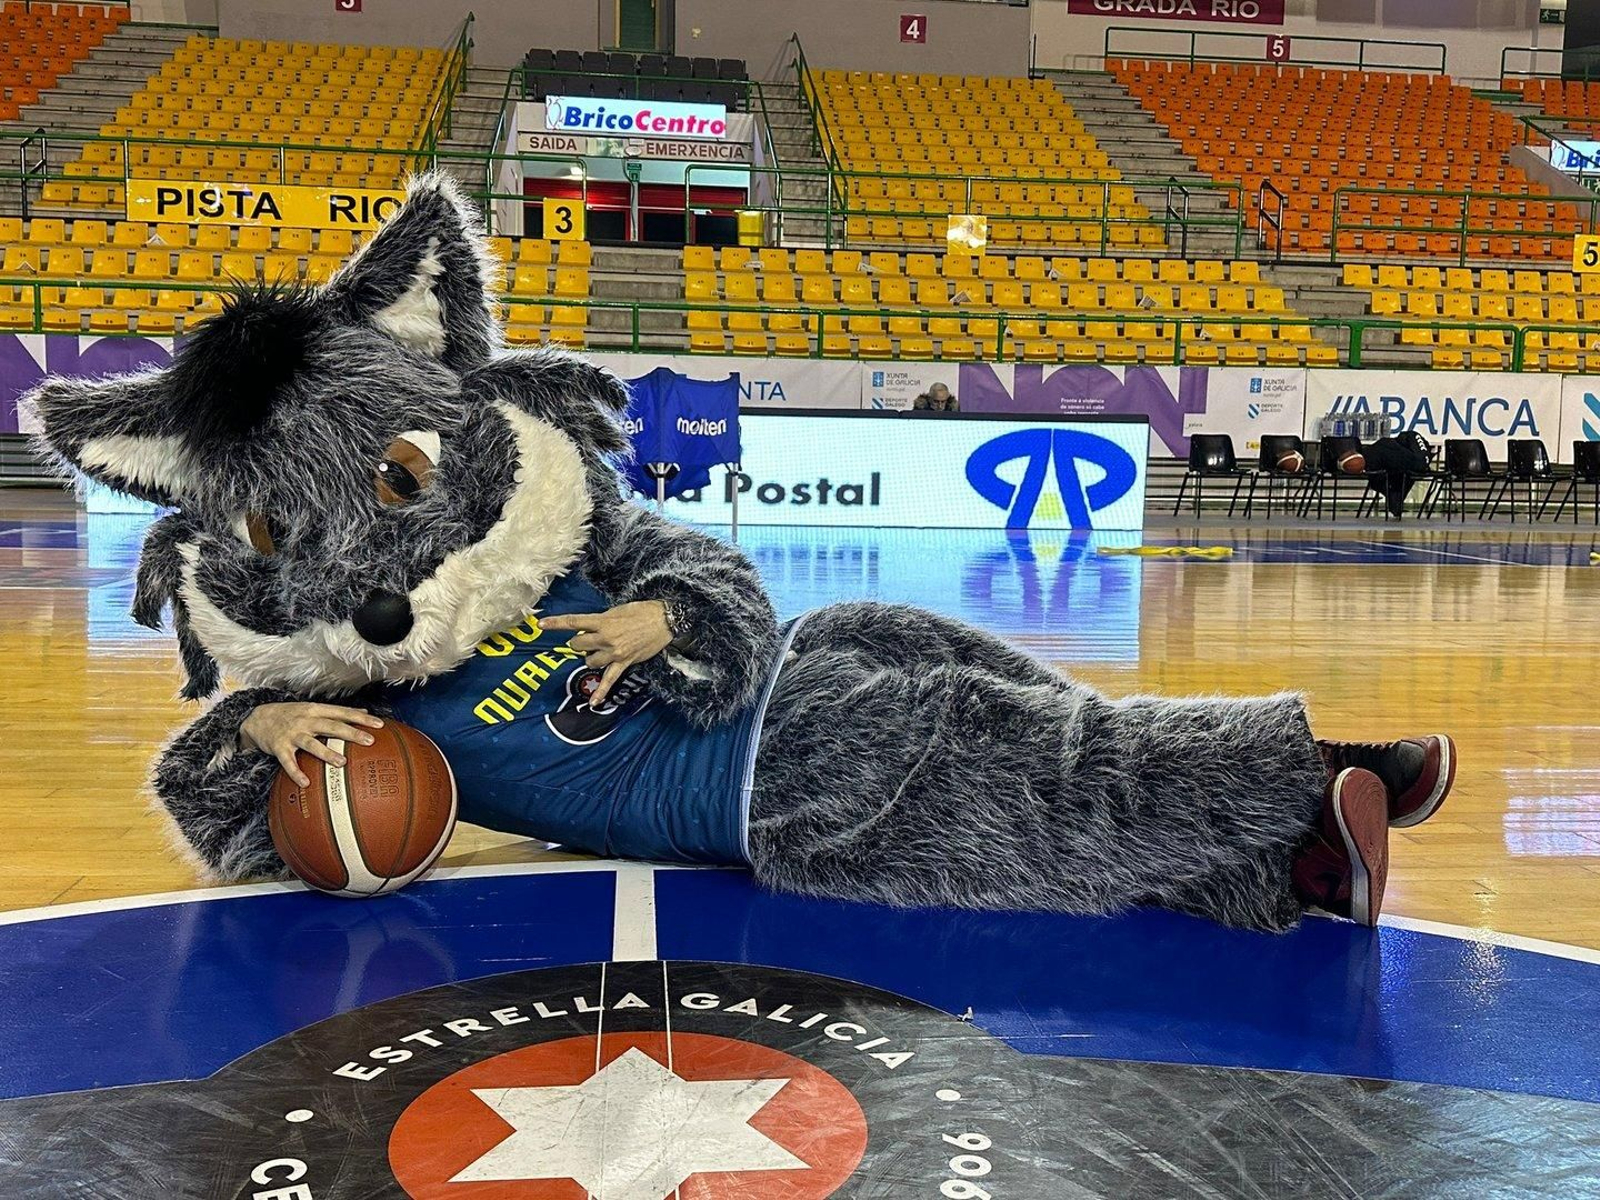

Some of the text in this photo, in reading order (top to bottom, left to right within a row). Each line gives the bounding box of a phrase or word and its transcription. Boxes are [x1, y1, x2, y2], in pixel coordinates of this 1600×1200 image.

[1094, 0, 1260, 18] GRADA RIO
[906, 19, 920, 39] 4
[1272, 39, 1284, 58] 5
[563, 105, 726, 135] BricoCentro
[529, 136, 745, 159] SAIDA EMERXENCIA
[156, 187, 402, 223] PISTA RIO
[554, 206, 573, 233] 3
[1582, 241, 1599, 267] 5
[676, 416, 727, 437] molten
[724, 471, 881, 506] Postal
[332, 991, 916, 1082] ESTRELLA GALICIA
